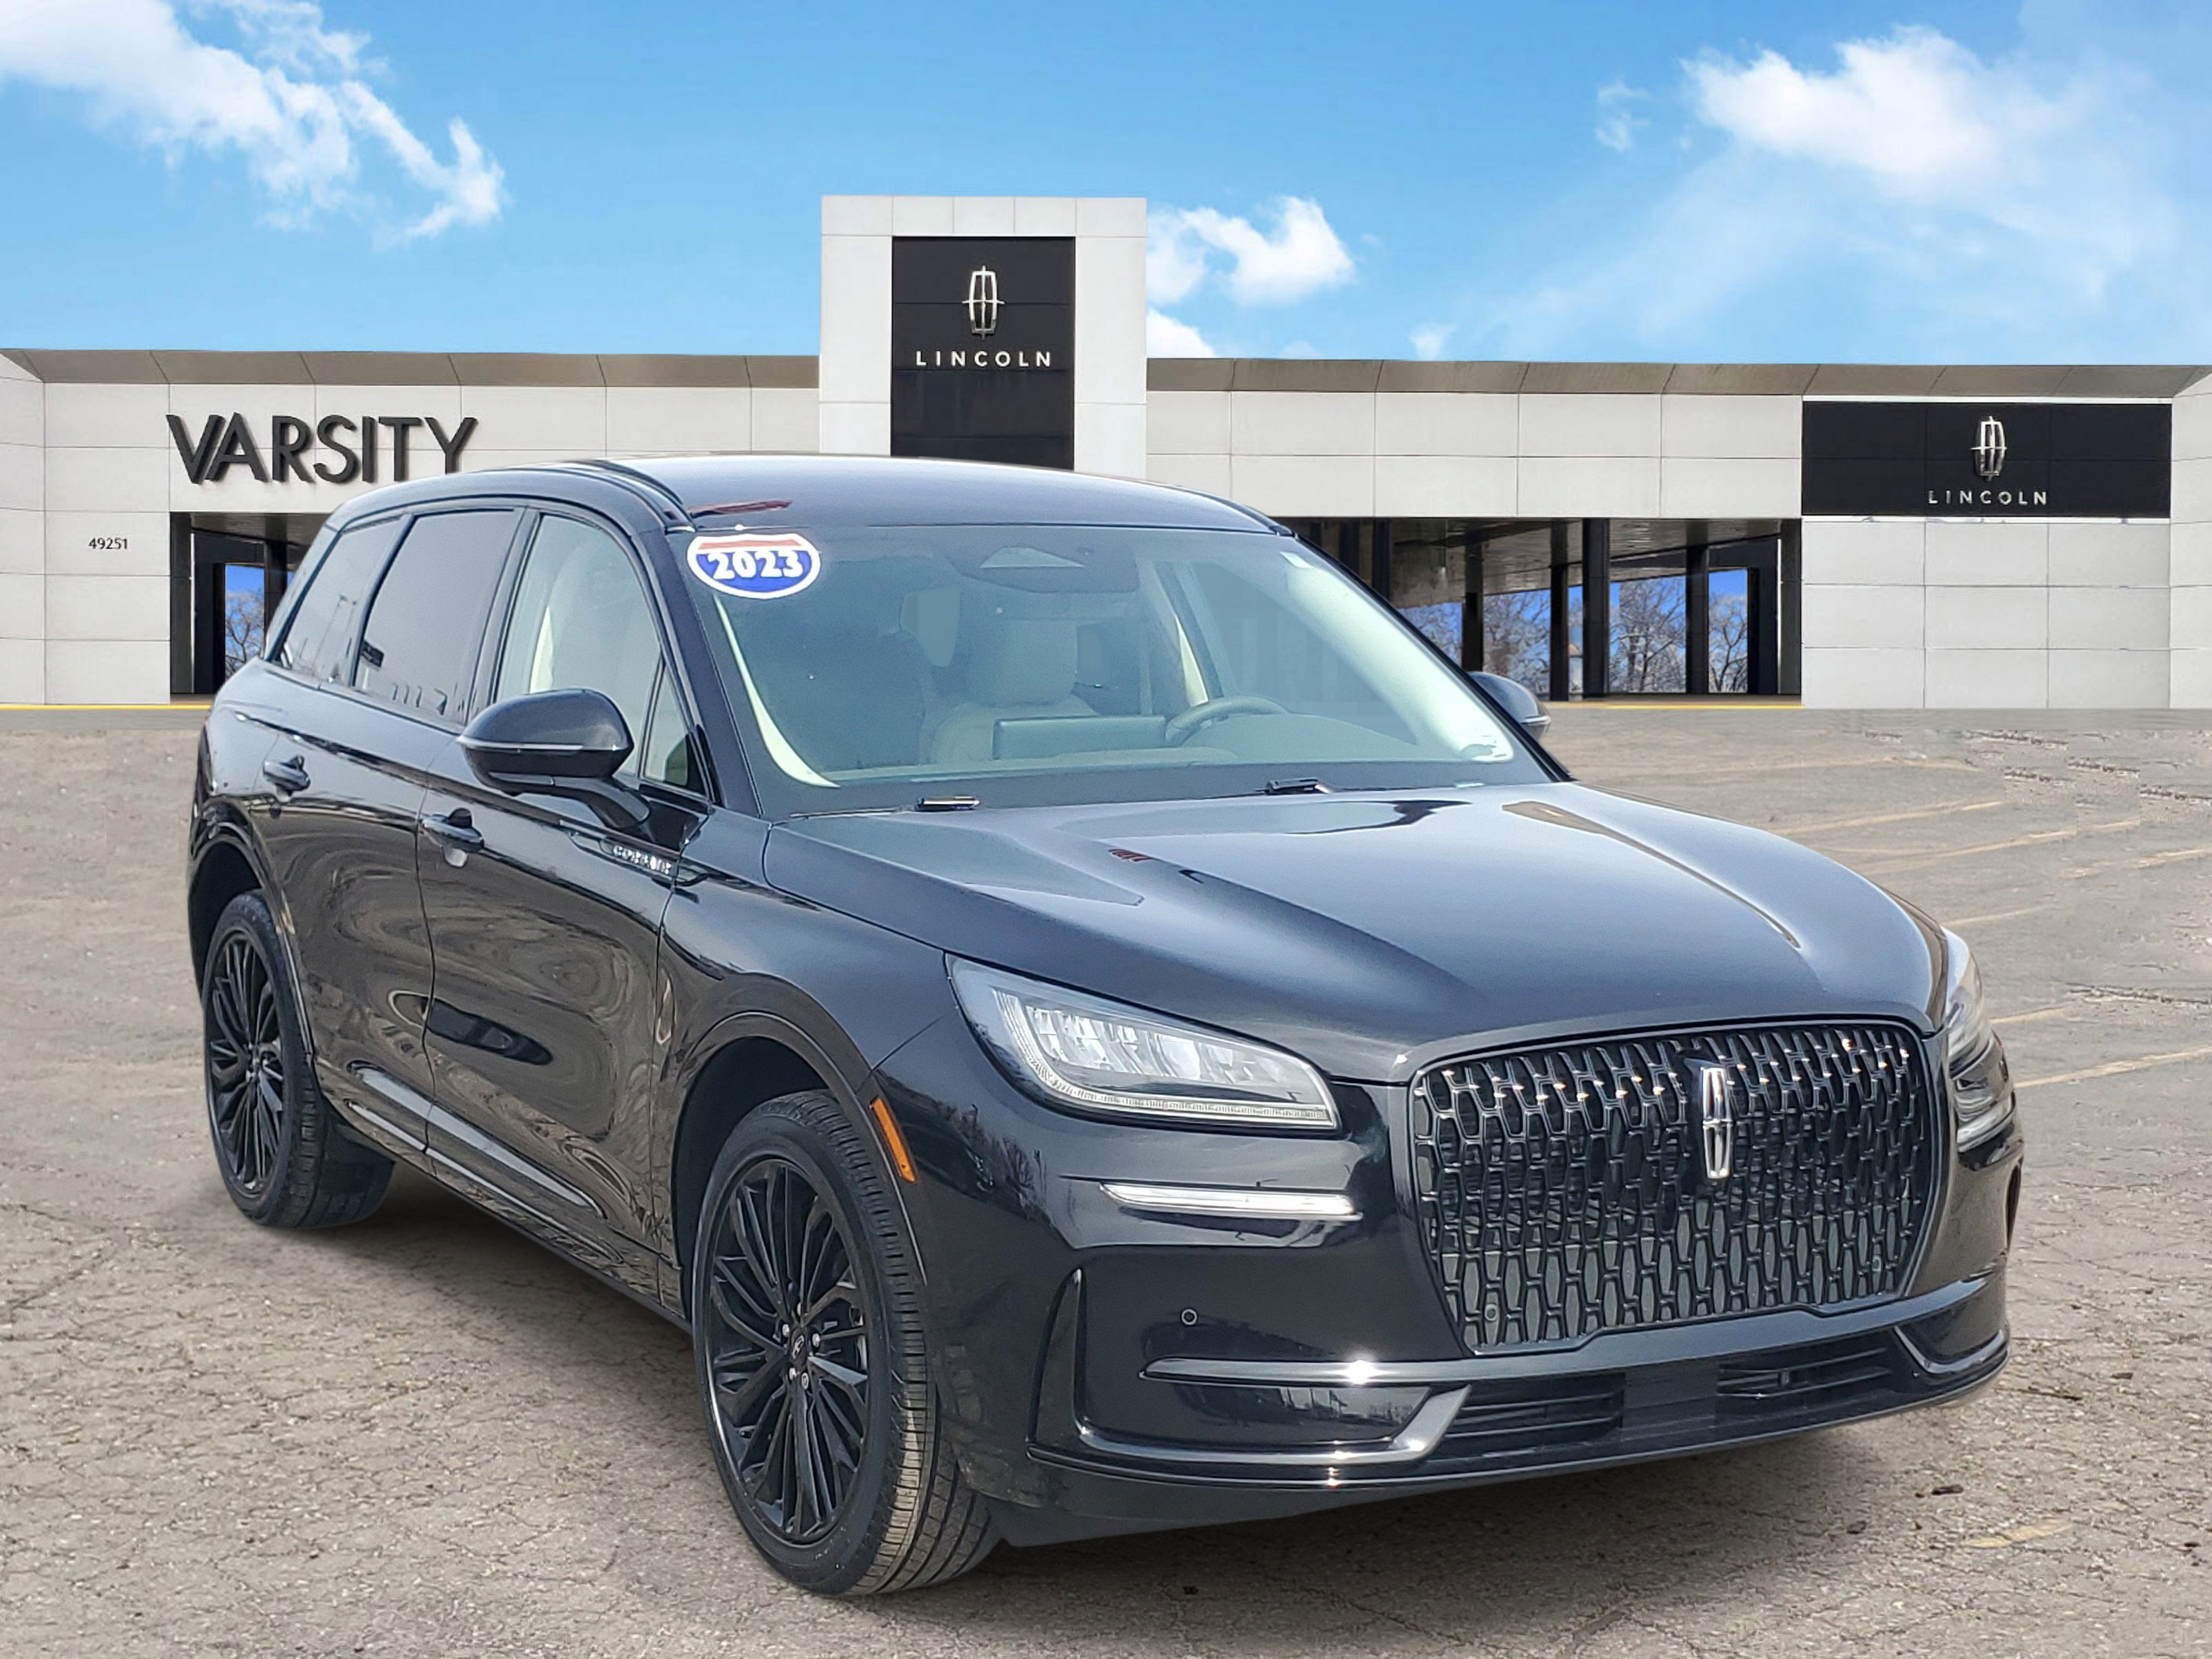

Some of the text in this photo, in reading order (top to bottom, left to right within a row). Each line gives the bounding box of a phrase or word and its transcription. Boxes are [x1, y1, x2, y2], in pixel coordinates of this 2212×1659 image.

[916, 351, 1051, 367] LINCOLN
[166, 412, 478, 484] VARSITY
[1928, 490, 2046, 505] LINCOLN
[88, 537, 127, 549] 49251
[708, 549, 803, 580] 2023
